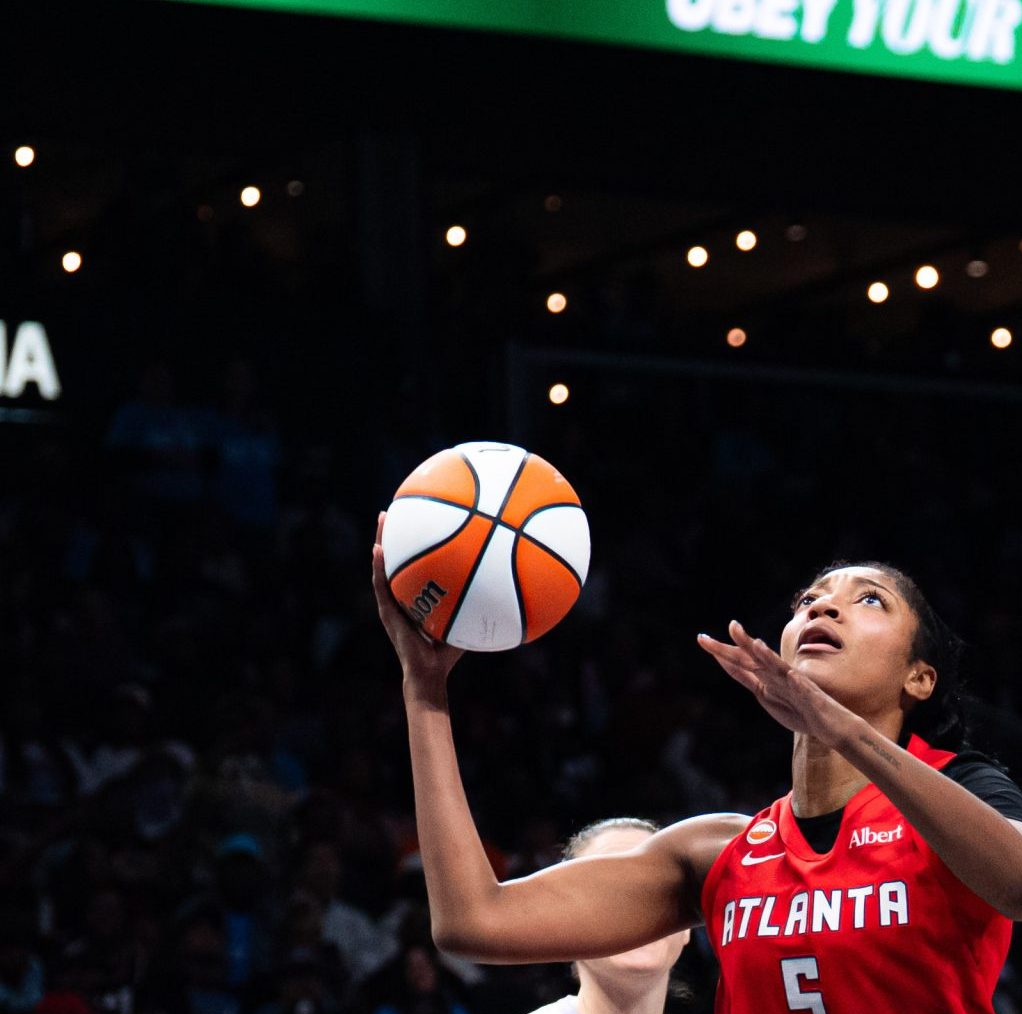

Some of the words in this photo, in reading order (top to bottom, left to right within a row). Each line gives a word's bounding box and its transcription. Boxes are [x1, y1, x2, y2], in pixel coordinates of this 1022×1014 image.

[0, 319, 61, 399] A
[848, 822, 904, 849] Albert
[721, 879, 910, 947] ATLANTA
